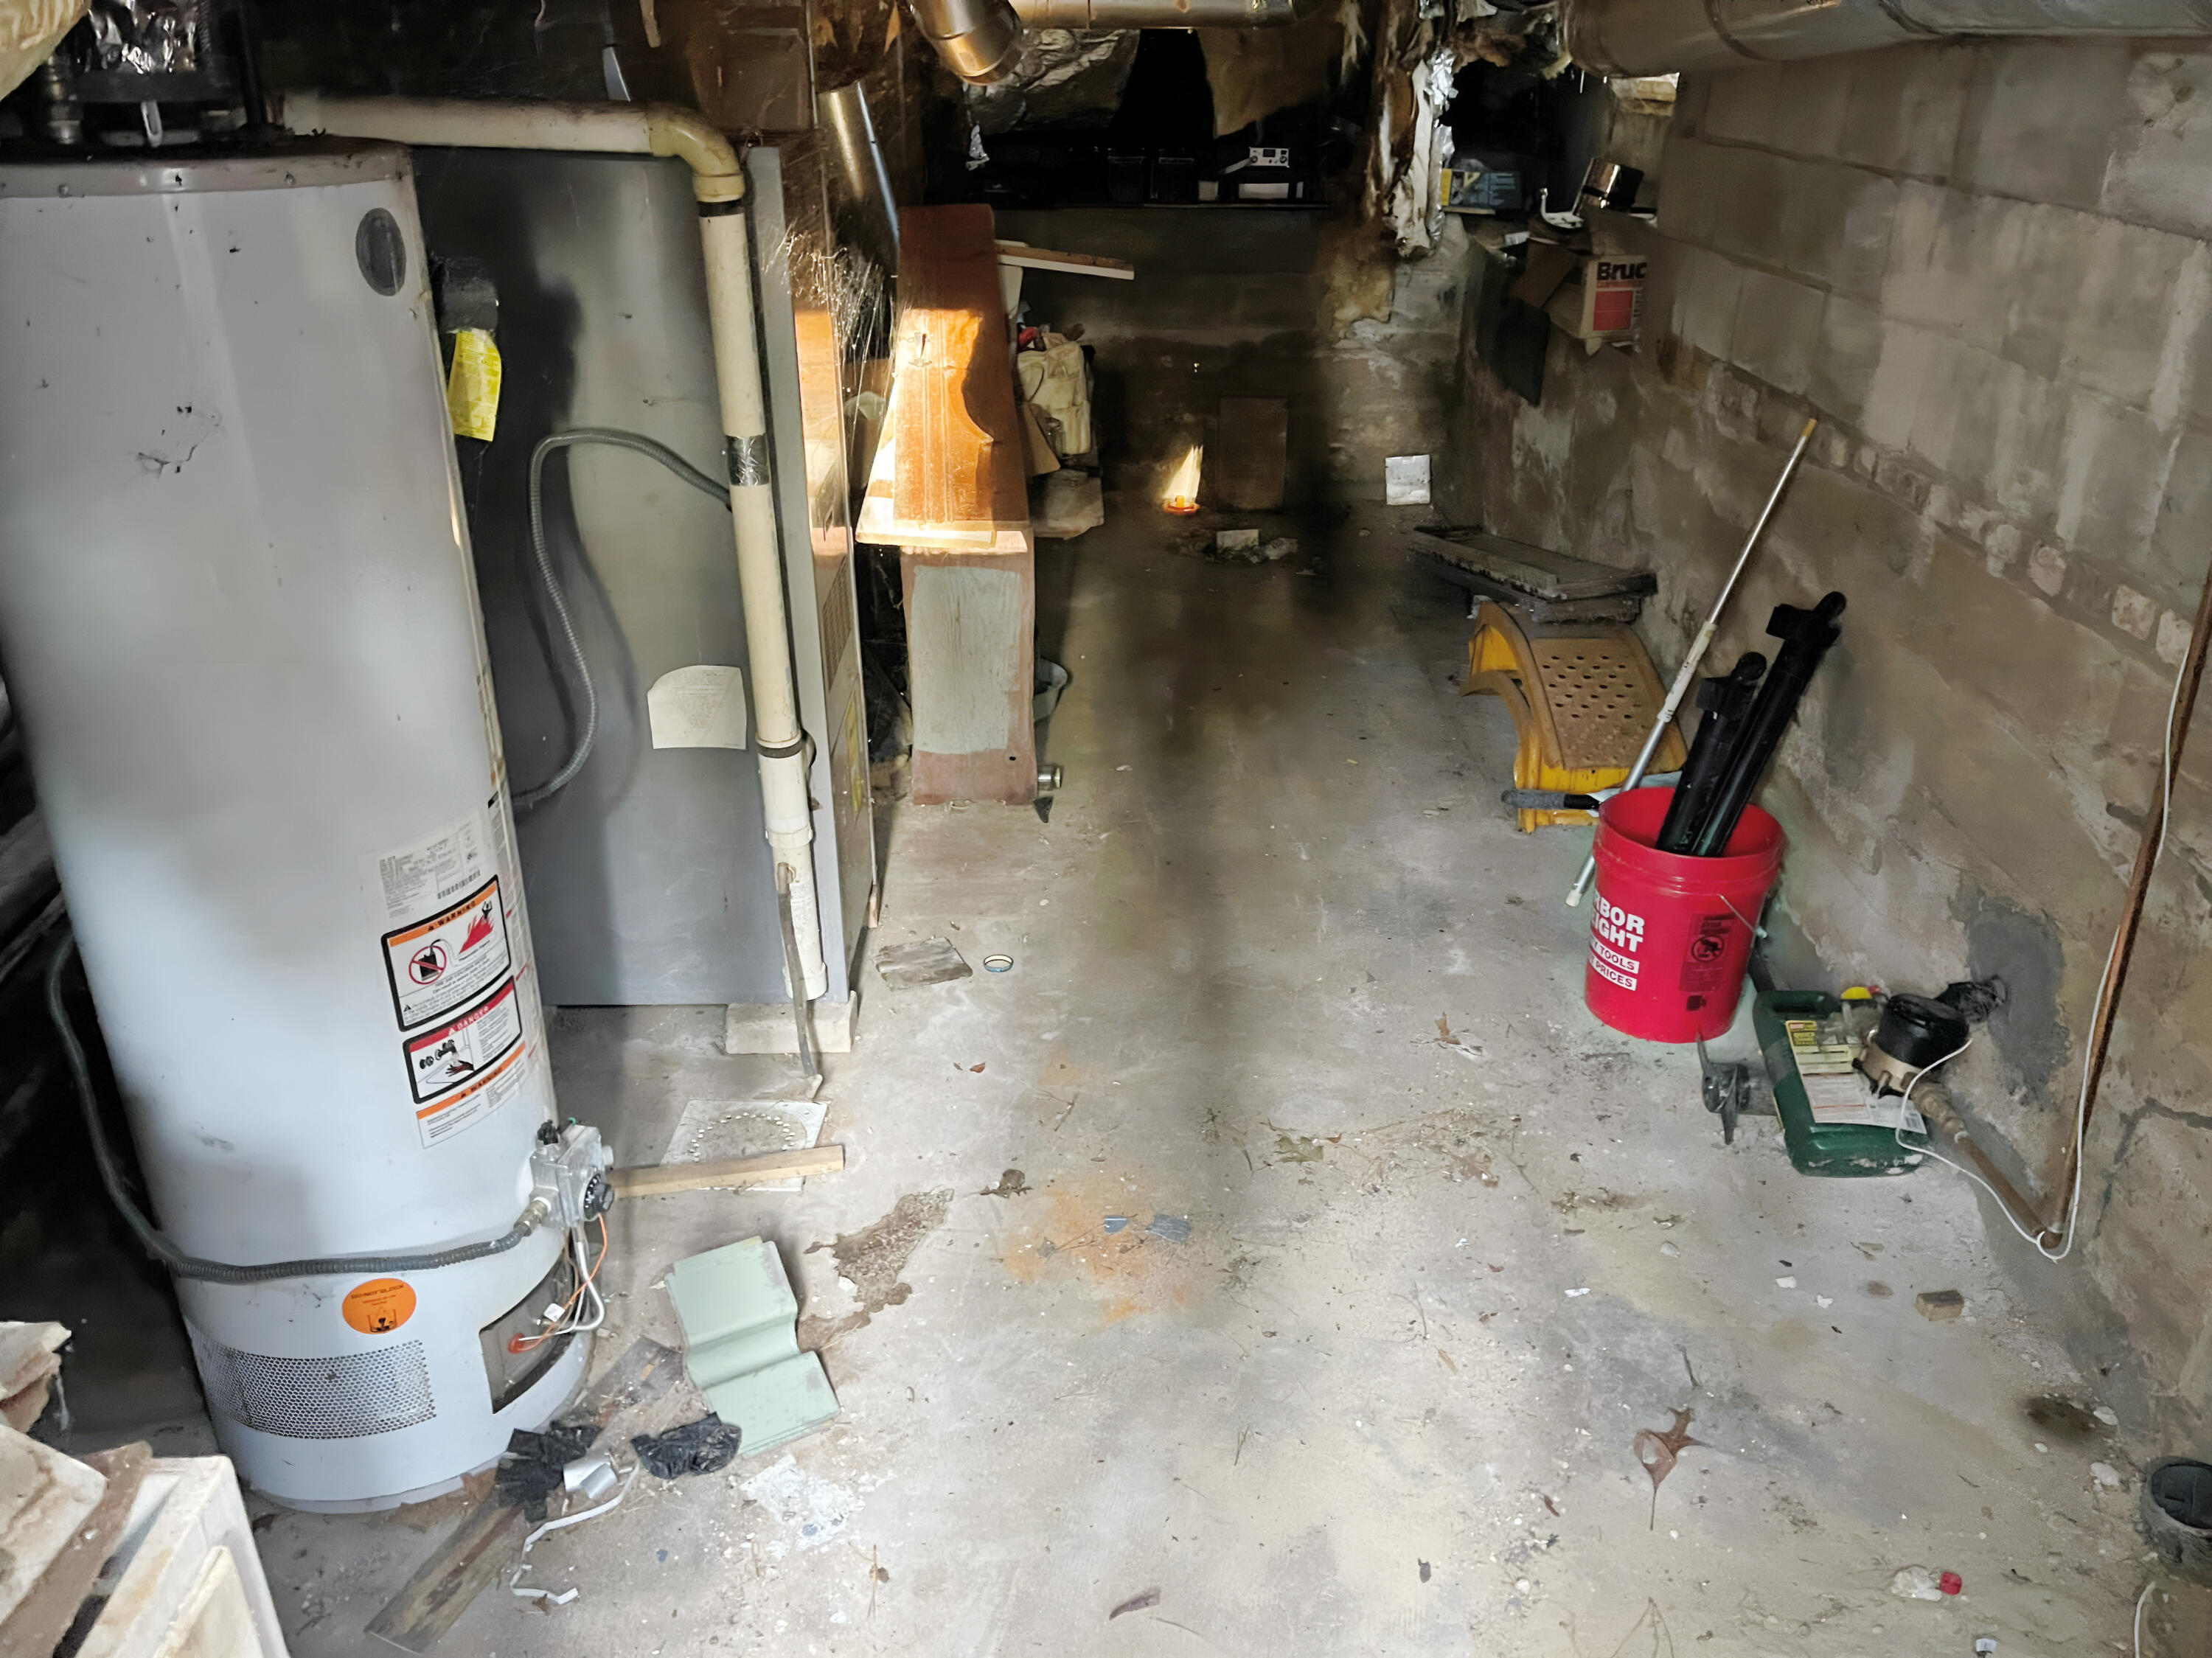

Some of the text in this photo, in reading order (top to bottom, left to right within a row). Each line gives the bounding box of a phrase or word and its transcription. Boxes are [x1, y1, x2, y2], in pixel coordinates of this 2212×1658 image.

[437, 900, 476, 926] WARNING
[1599, 945, 1635, 971] TOOLS
[1596, 960, 1633, 989] PRICES
[457, 1006, 489, 1031] DANGER
